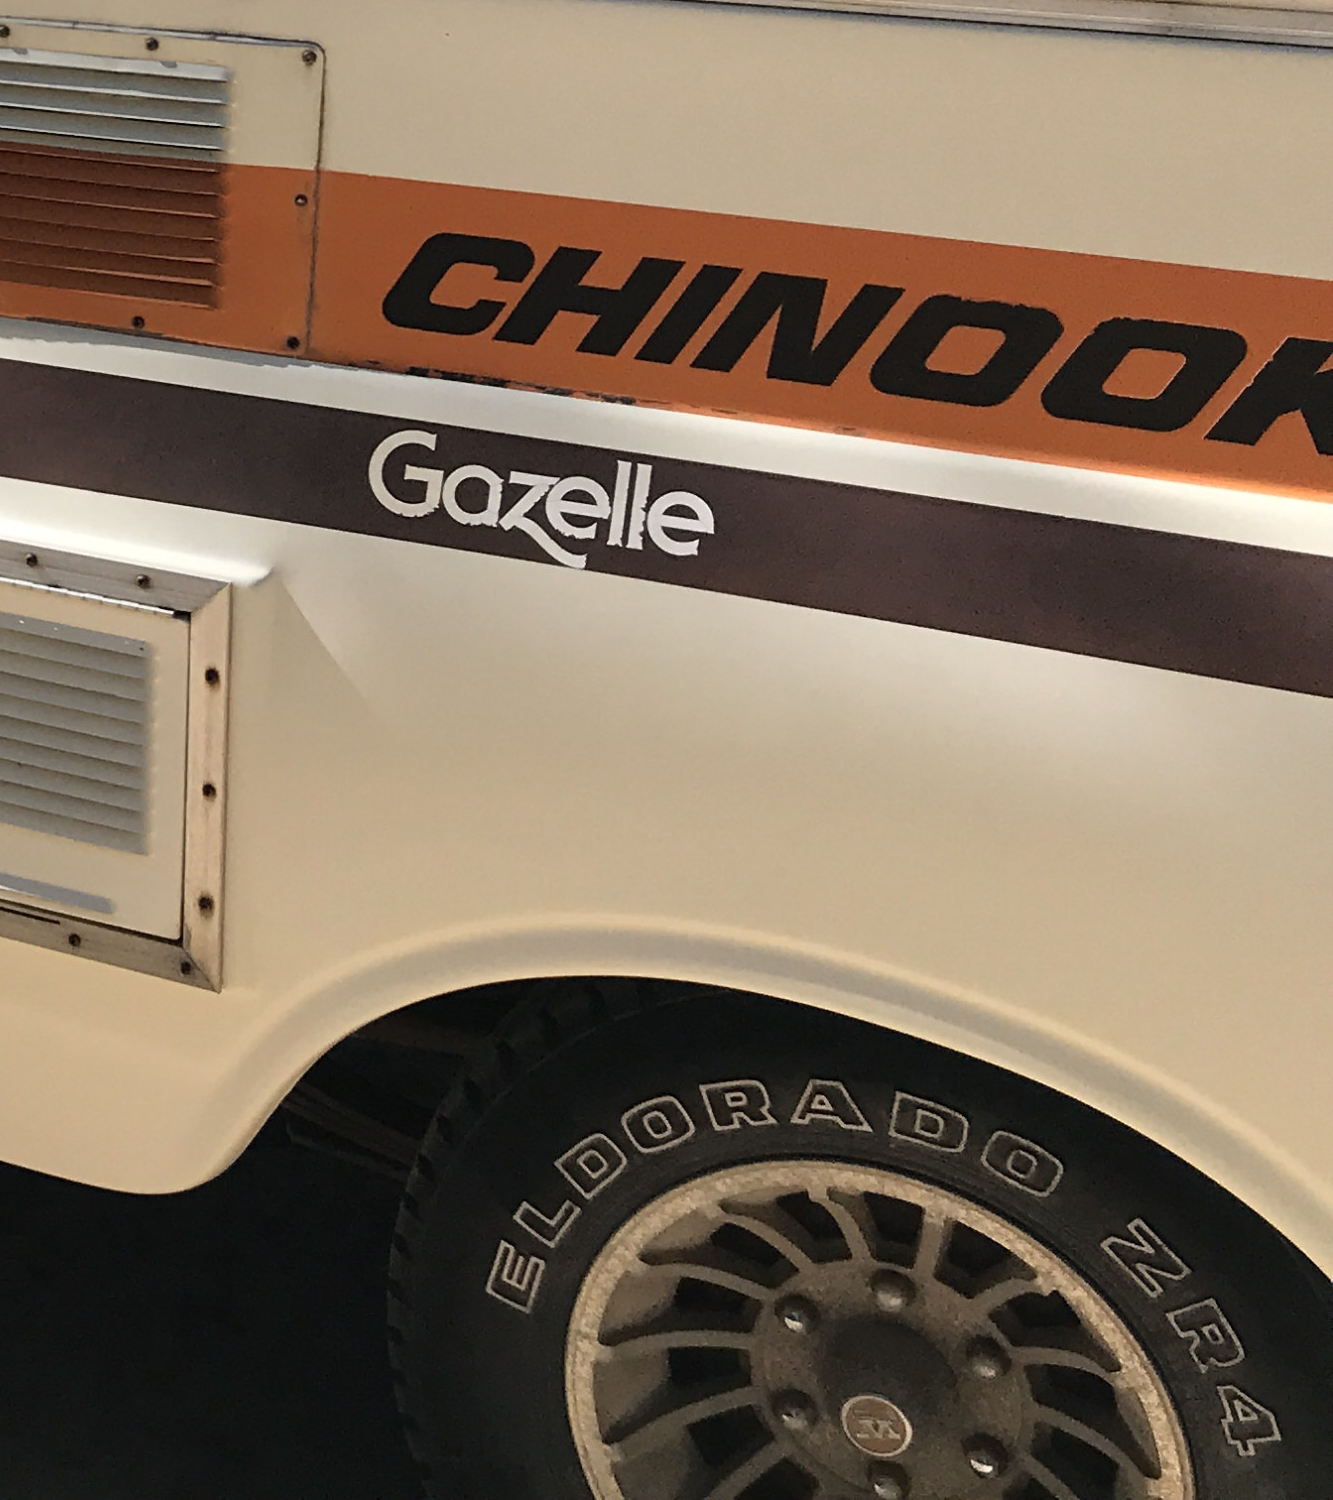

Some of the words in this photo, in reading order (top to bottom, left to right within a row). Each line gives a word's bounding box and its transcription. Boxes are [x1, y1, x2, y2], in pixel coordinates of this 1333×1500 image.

[381, 231, 1333, 456] CHINOOK
[368, 429, 715, 569] Gazelle
[485, 1079, 1064, 1314] ELDORADO
[1100, 1218, 1282, 1457] ZR4
